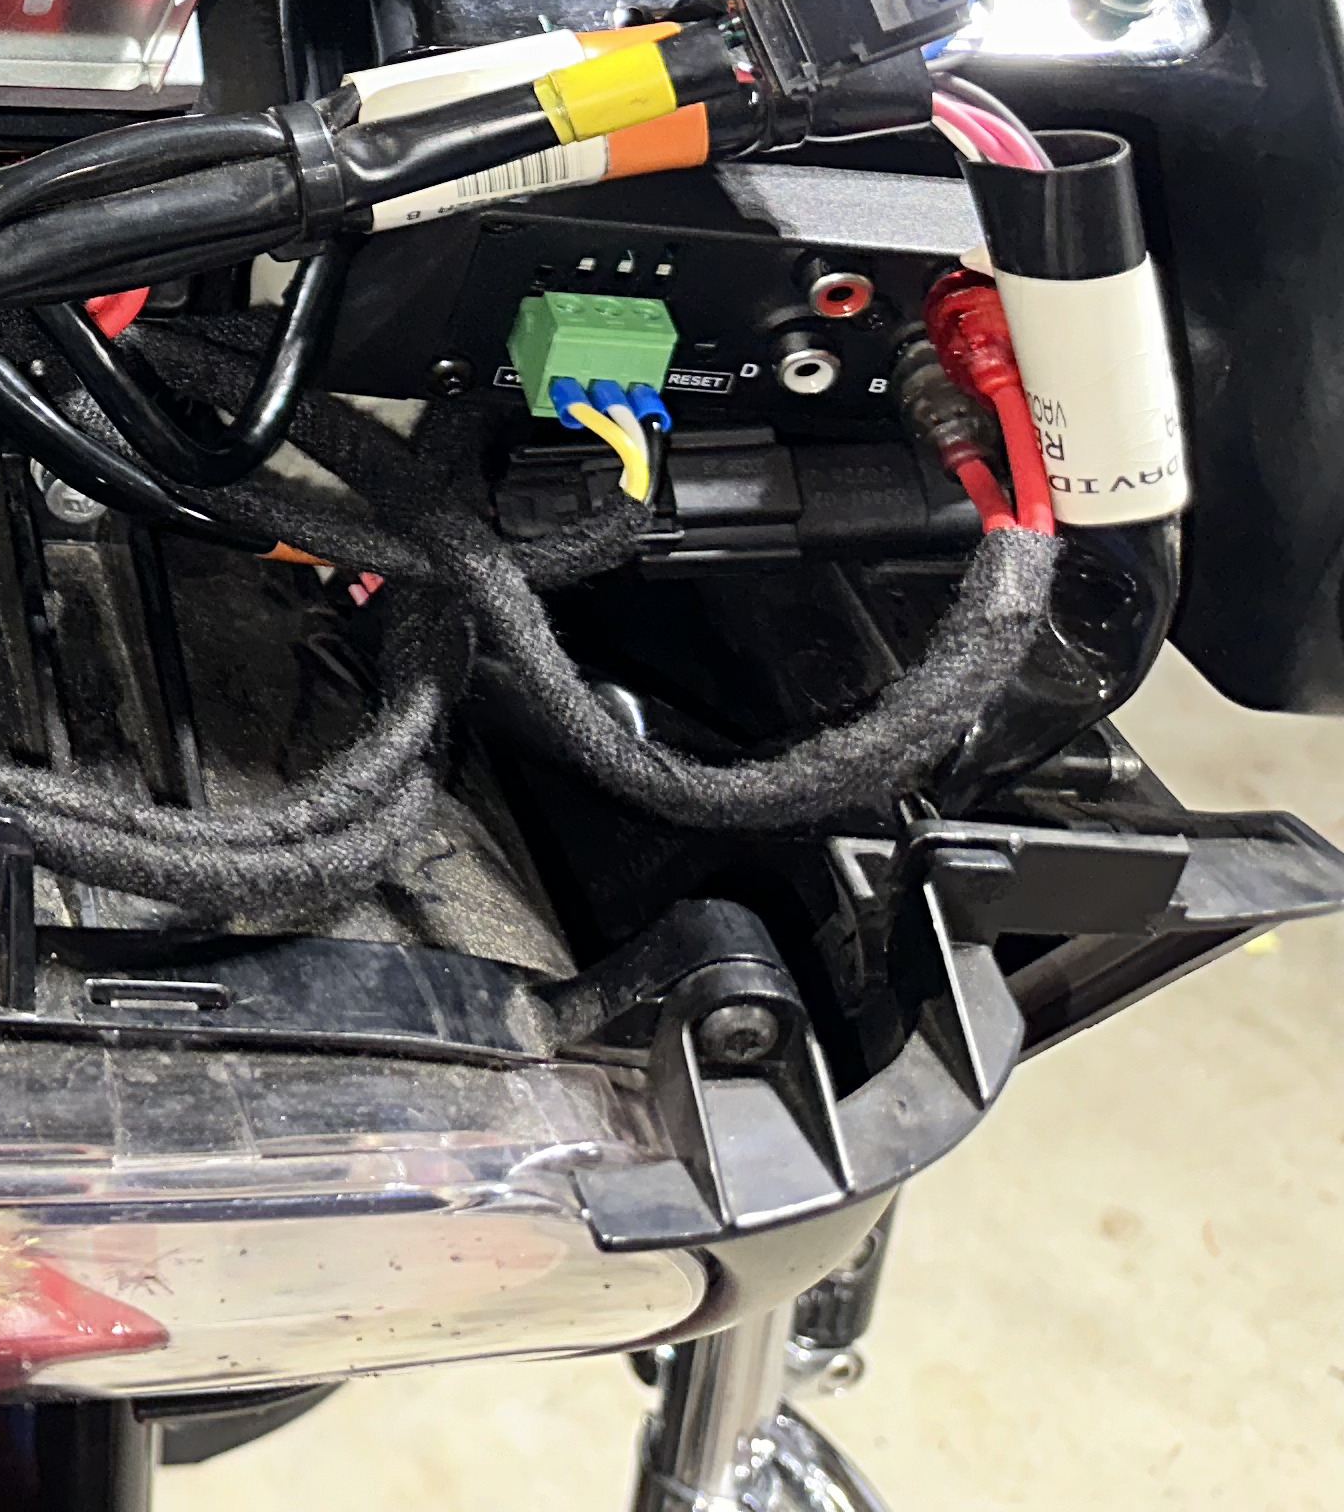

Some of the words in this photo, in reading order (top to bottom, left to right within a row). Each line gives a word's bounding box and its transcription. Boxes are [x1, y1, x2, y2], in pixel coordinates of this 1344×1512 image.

[740, 363, 760, 378] D
[667, 373, 724, 388] RESET
[869, 378, 888, 393] B
